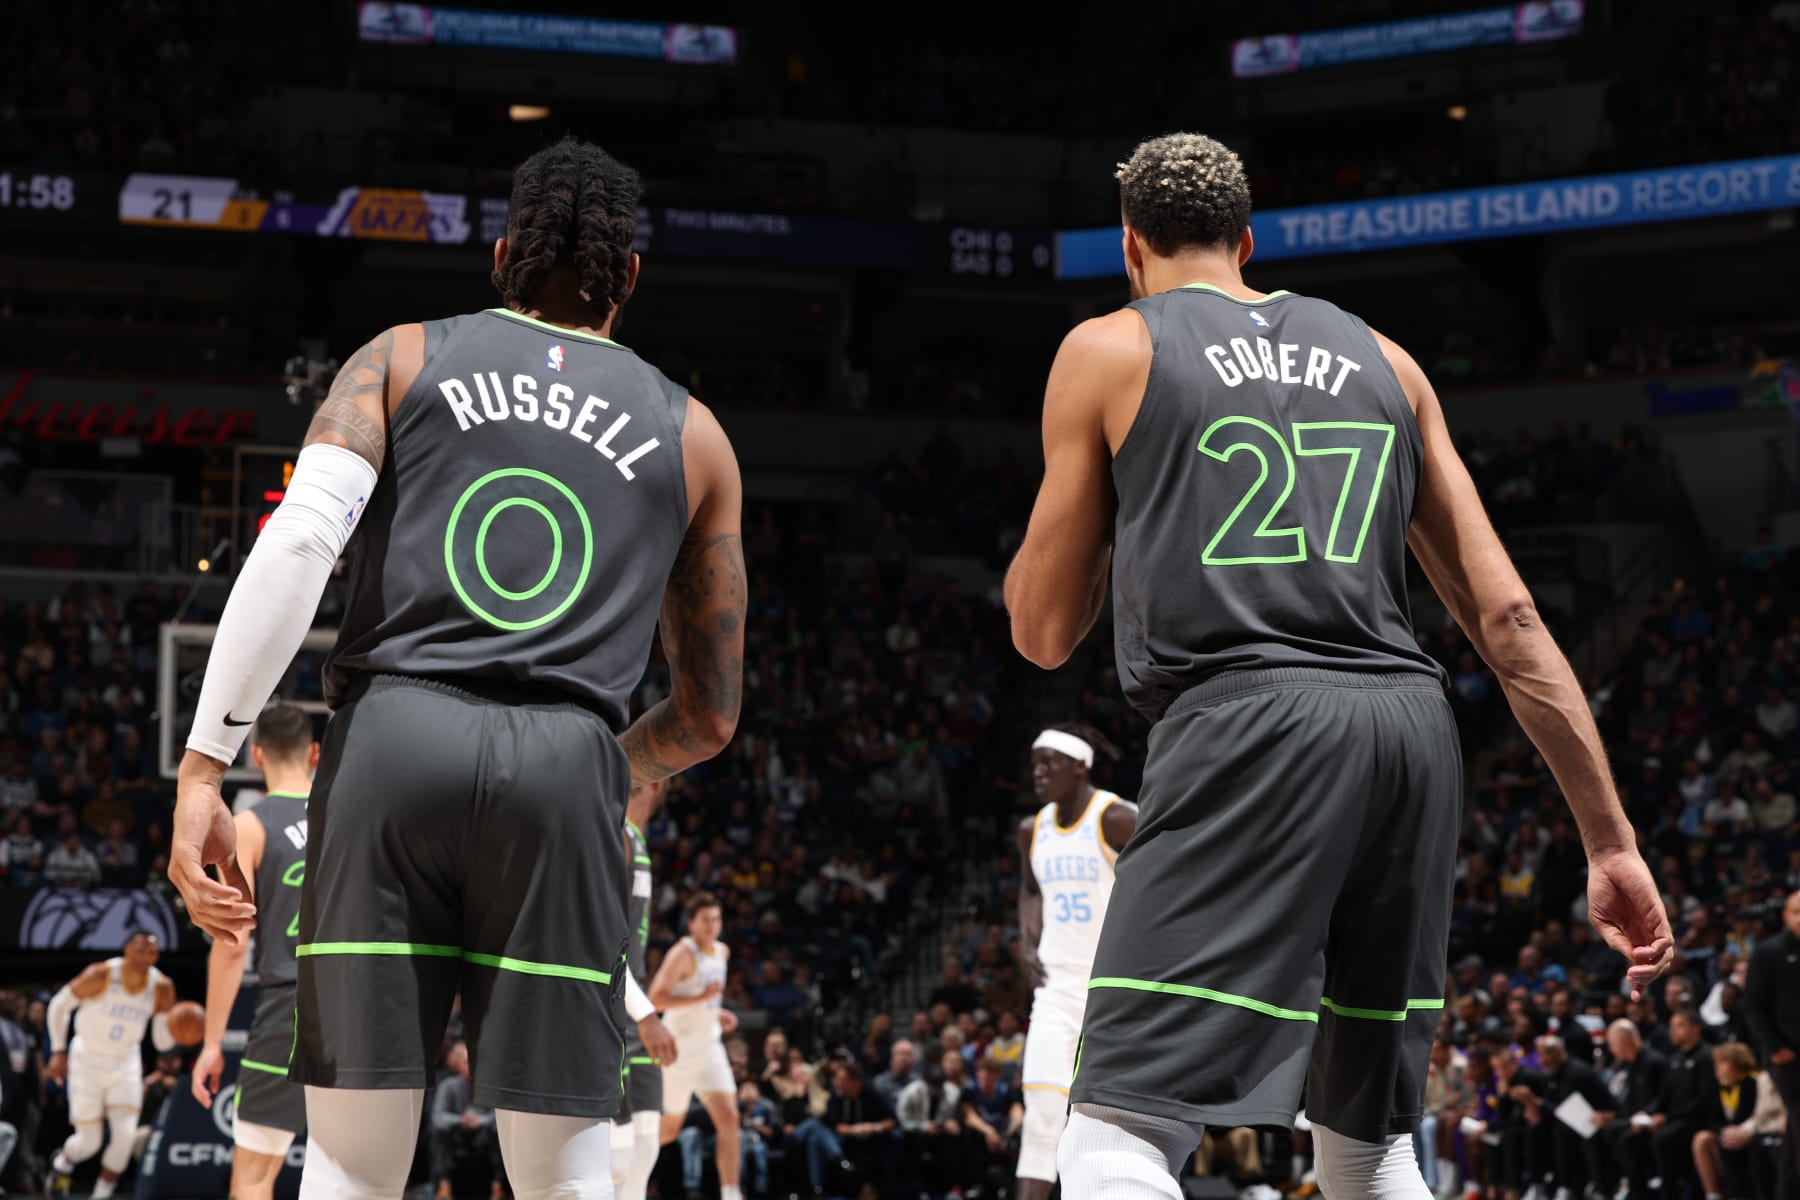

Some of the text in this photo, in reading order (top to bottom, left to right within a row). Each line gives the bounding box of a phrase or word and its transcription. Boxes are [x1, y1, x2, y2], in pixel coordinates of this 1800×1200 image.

[154, 190, 192, 220] 21
[1279, 200, 1471, 247] TREASURE
[1479, 184, 1621, 227] ISLAND
[1632, 166, 1777, 213] RESORT
[1204, 336, 1361, 397] GOBERT
[438, 371, 661, 482] RUSSELL
[1198, 415, 1395, 565] 27
[444, 467, 594, 631] 0
[1053, 892, 1092, 923] 35
